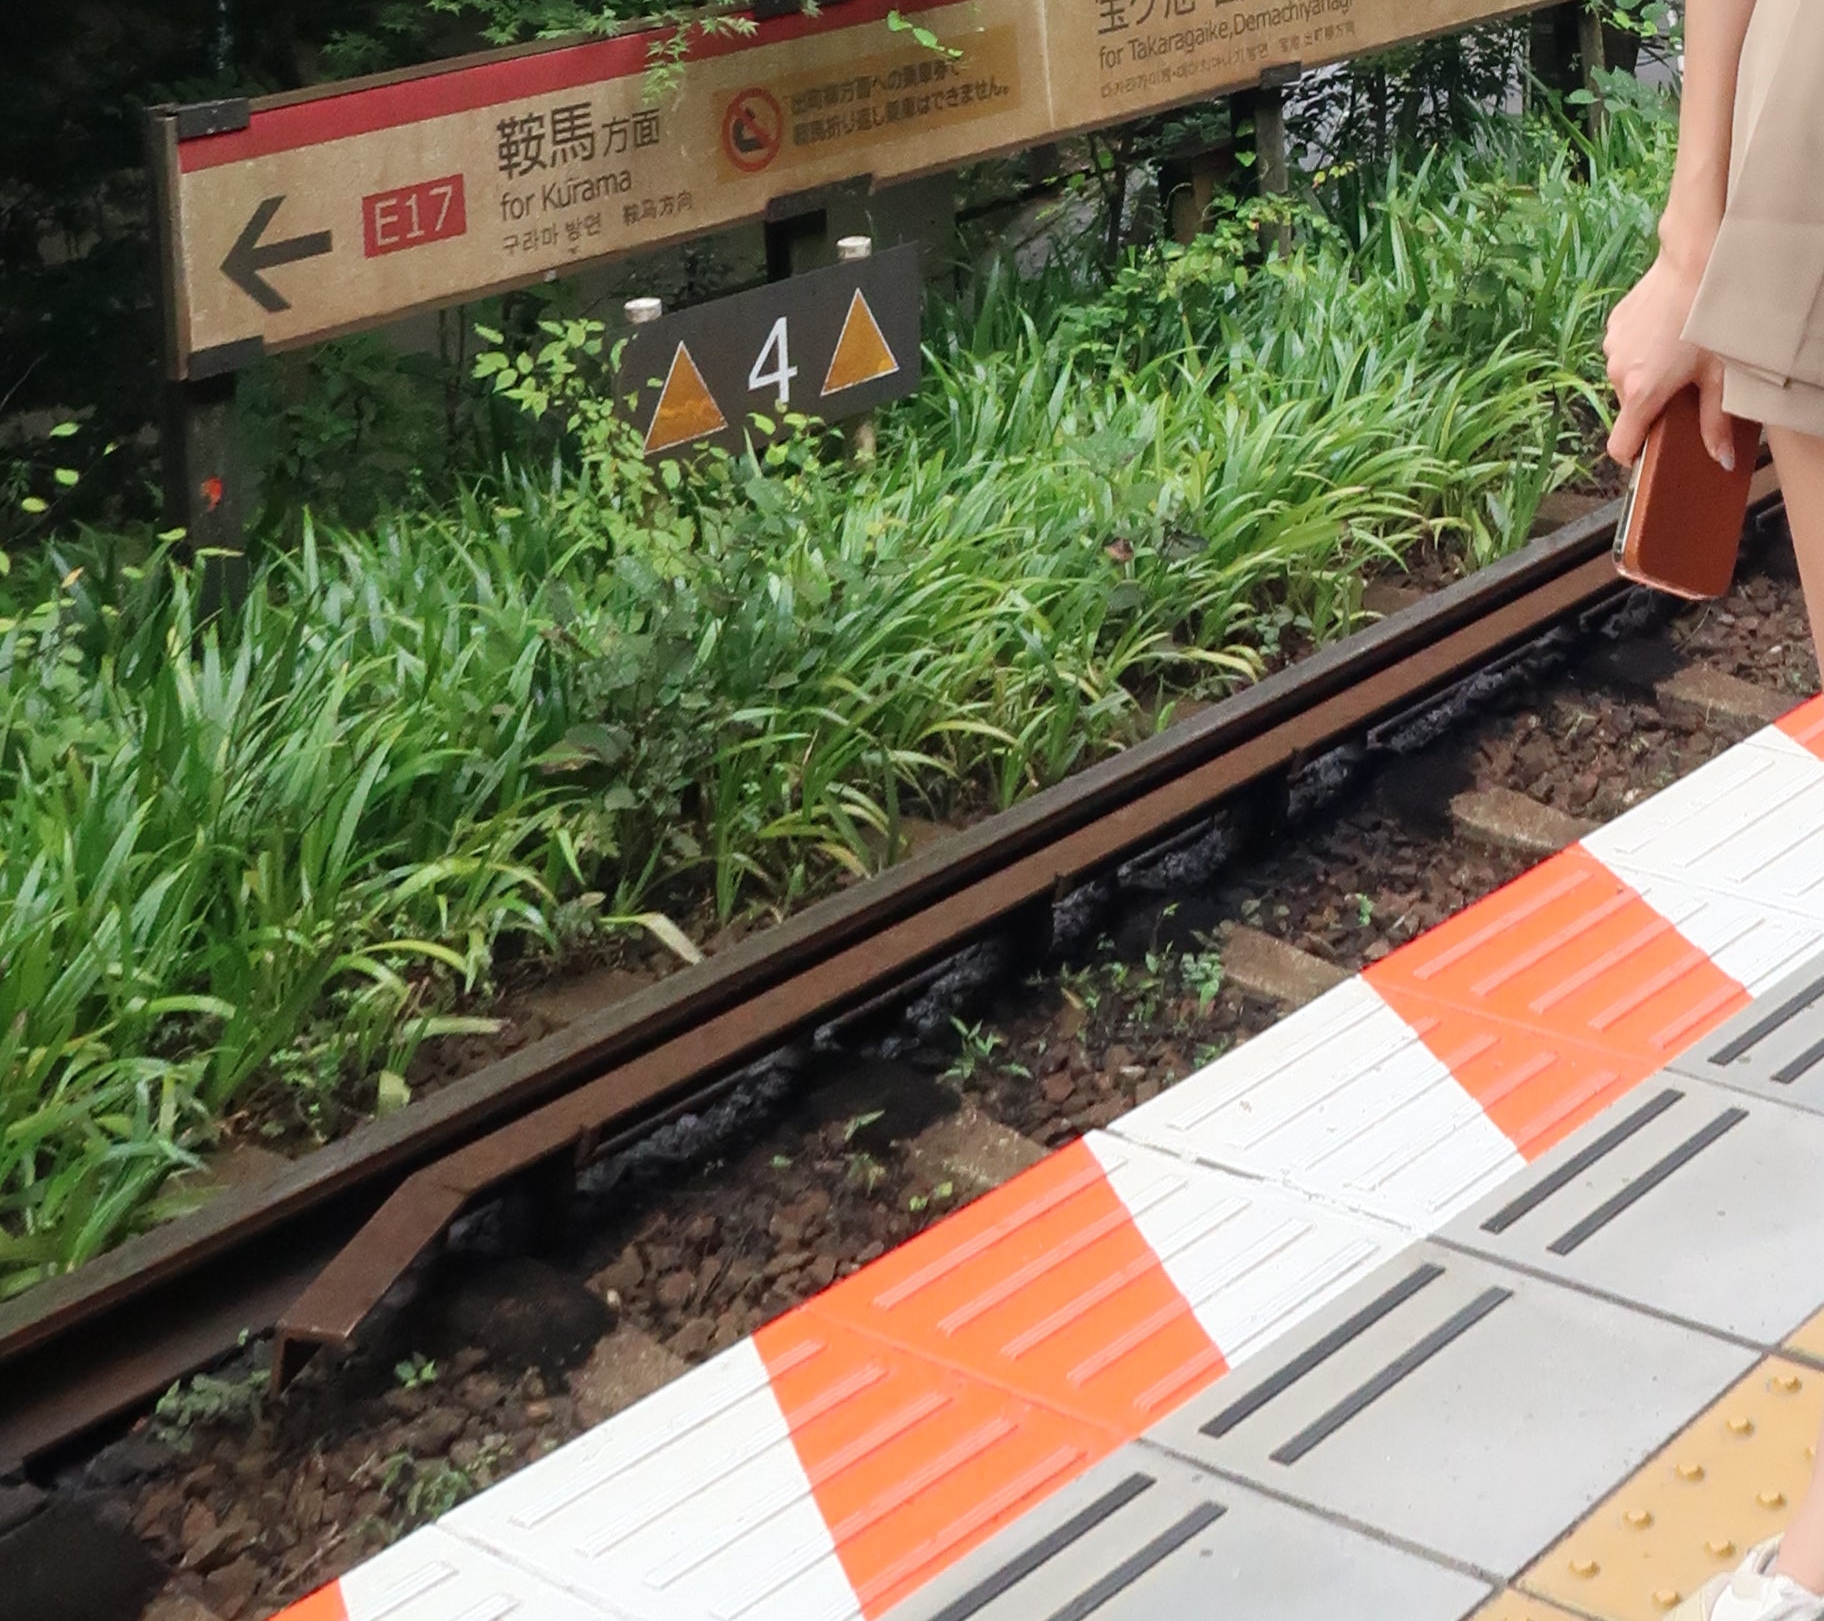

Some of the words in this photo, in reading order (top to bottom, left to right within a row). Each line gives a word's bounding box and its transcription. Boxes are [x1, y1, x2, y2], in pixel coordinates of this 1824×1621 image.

[1100, 45, 1125, 70] for
[497, 101, 661, 181] 鞍馬方面
[374, 186, 454, 247] E17
[500, 191, 535, 222] for
[748, 316, 798, 405] 4
